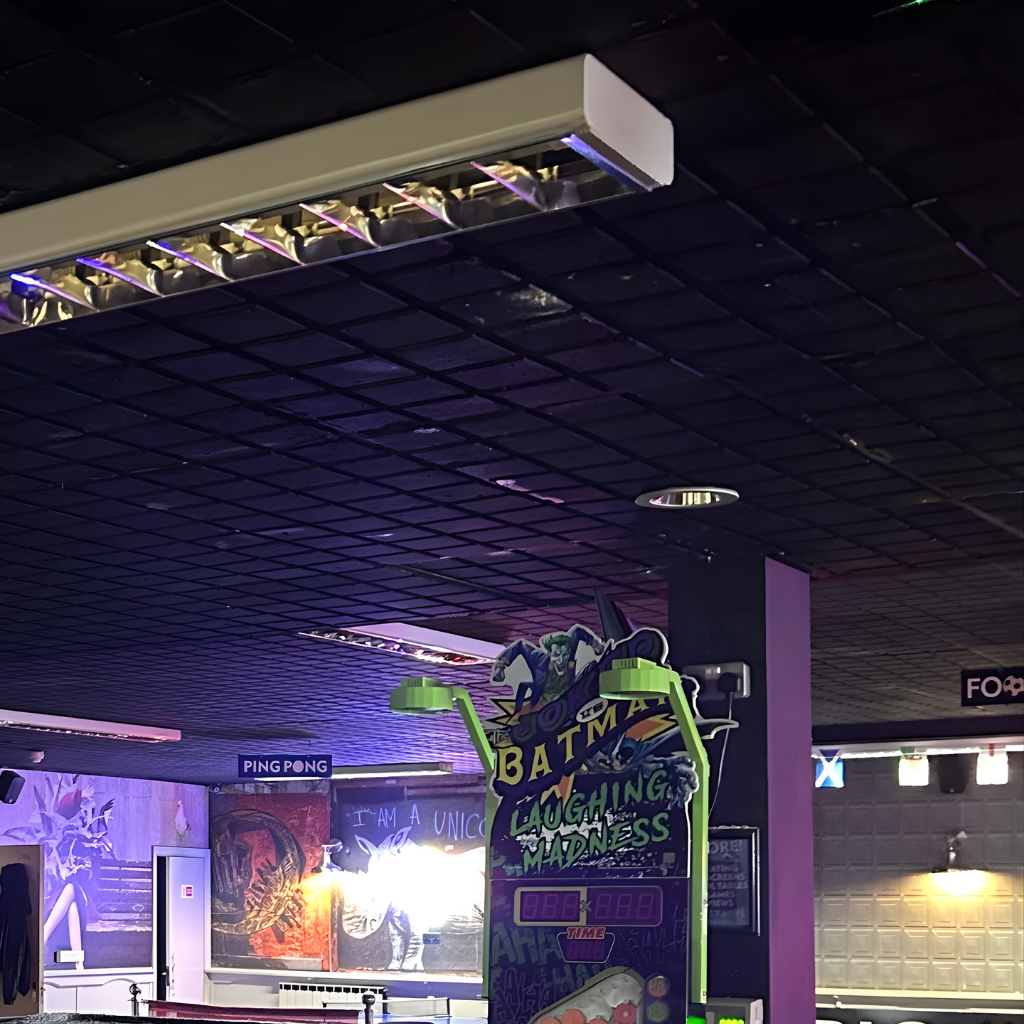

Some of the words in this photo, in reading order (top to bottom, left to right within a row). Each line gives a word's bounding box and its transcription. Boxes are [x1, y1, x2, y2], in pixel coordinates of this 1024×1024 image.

[496, 697, 670, 785] BATMA
[243, 760, 281, 773] PING
[283, 759, 328, 773] PONG
[510, 768, 668, 837] LAUGHING
[378, 807, 397, 829] AM
[409, 803, 421, 825] A
[523, 812, 671, 876] MADNESS
[709, 840, 744, 854] ORE!
[567, 928, 606, 939] TIME
